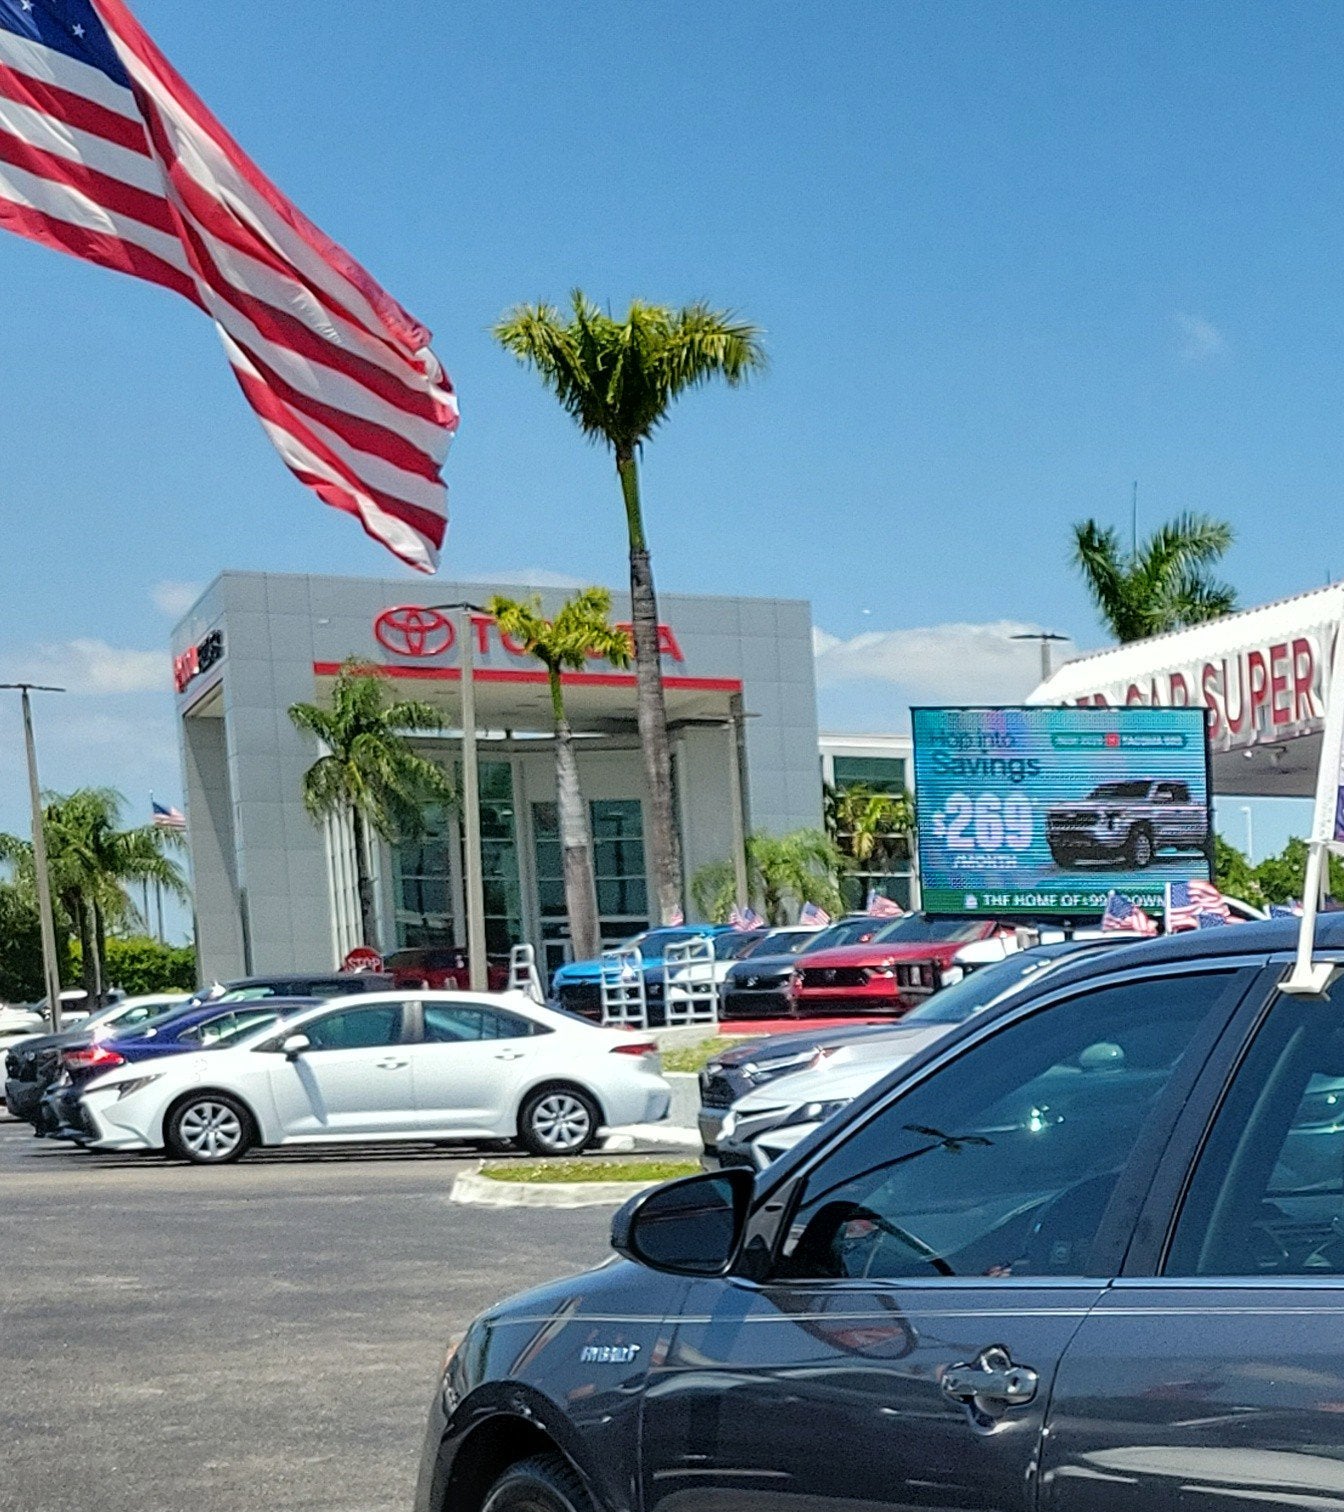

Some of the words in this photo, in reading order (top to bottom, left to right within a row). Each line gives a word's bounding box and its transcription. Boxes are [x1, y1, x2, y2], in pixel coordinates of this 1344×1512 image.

[932, 750, 1042, 783] Savings
[1012, 894, 1059, 907] HOME
[1121, 893, 1167, 908] OWN
